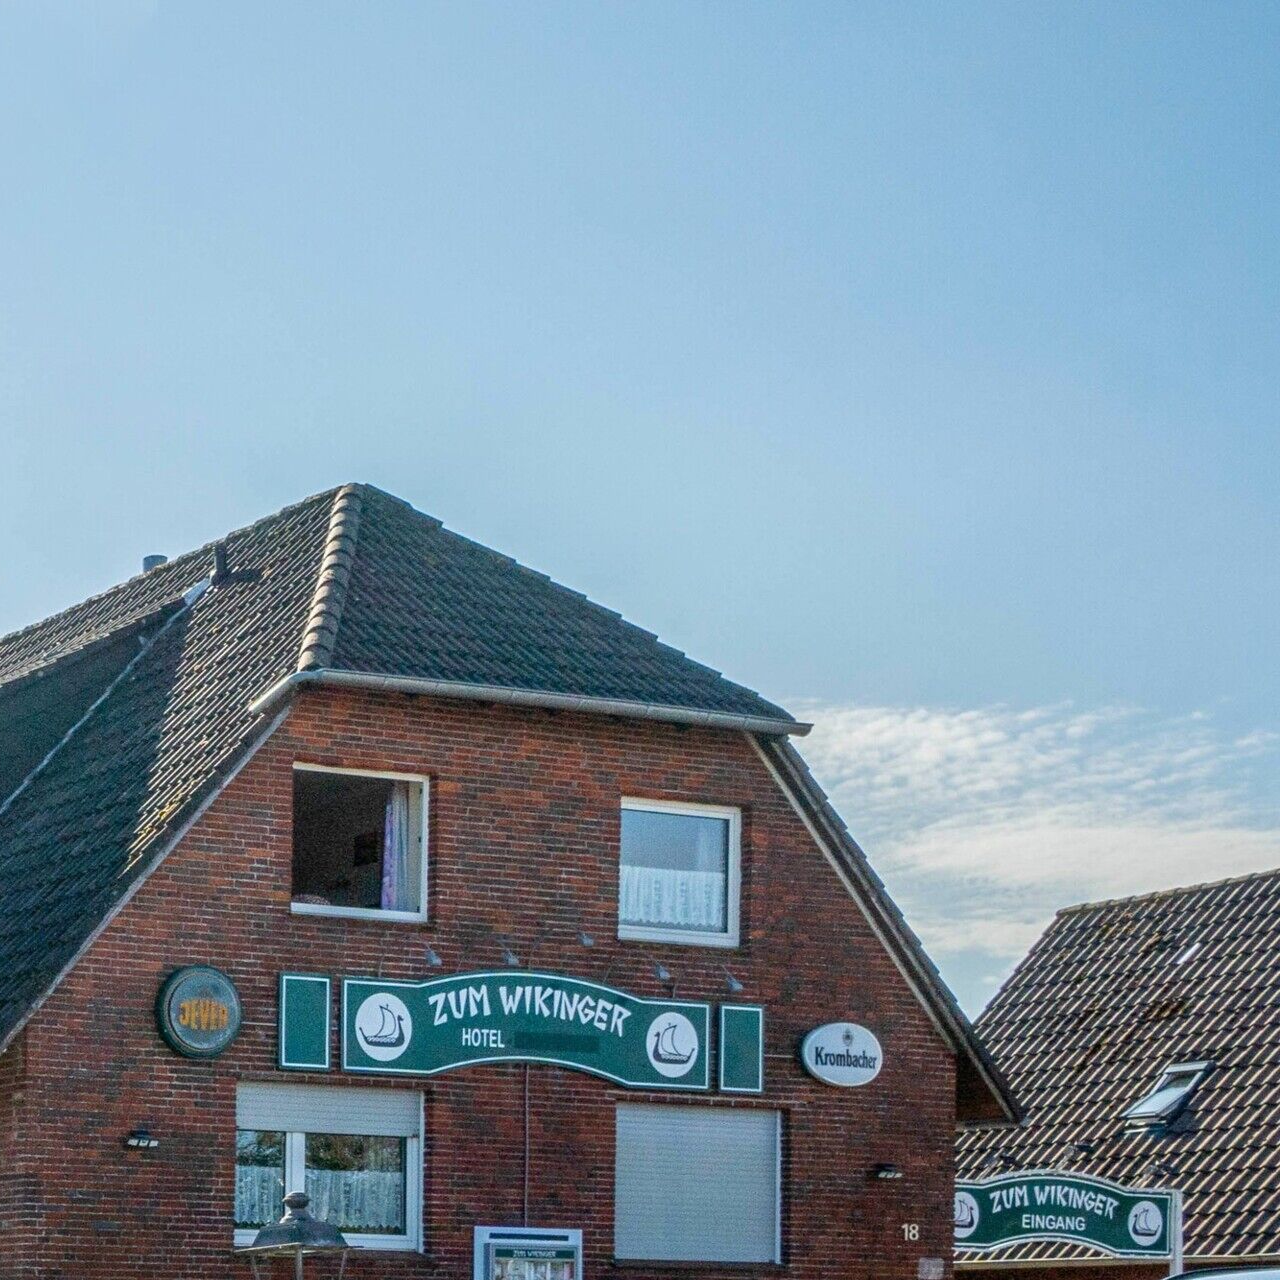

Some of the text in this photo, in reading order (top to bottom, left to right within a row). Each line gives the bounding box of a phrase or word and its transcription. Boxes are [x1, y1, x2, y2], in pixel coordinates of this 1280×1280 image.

[428, 984, 632, 1038] ZUM WIKINGER
[461, 1027, 505, 1049] HOTEL
[814, 1045, 877, 1070] Krombacher
[989, 1185, 1120, 1220] ZUM WIKINGER
[901, 1223, 919, 1241] 18
[1021, 1214, 1086, 1232] EINGANG
